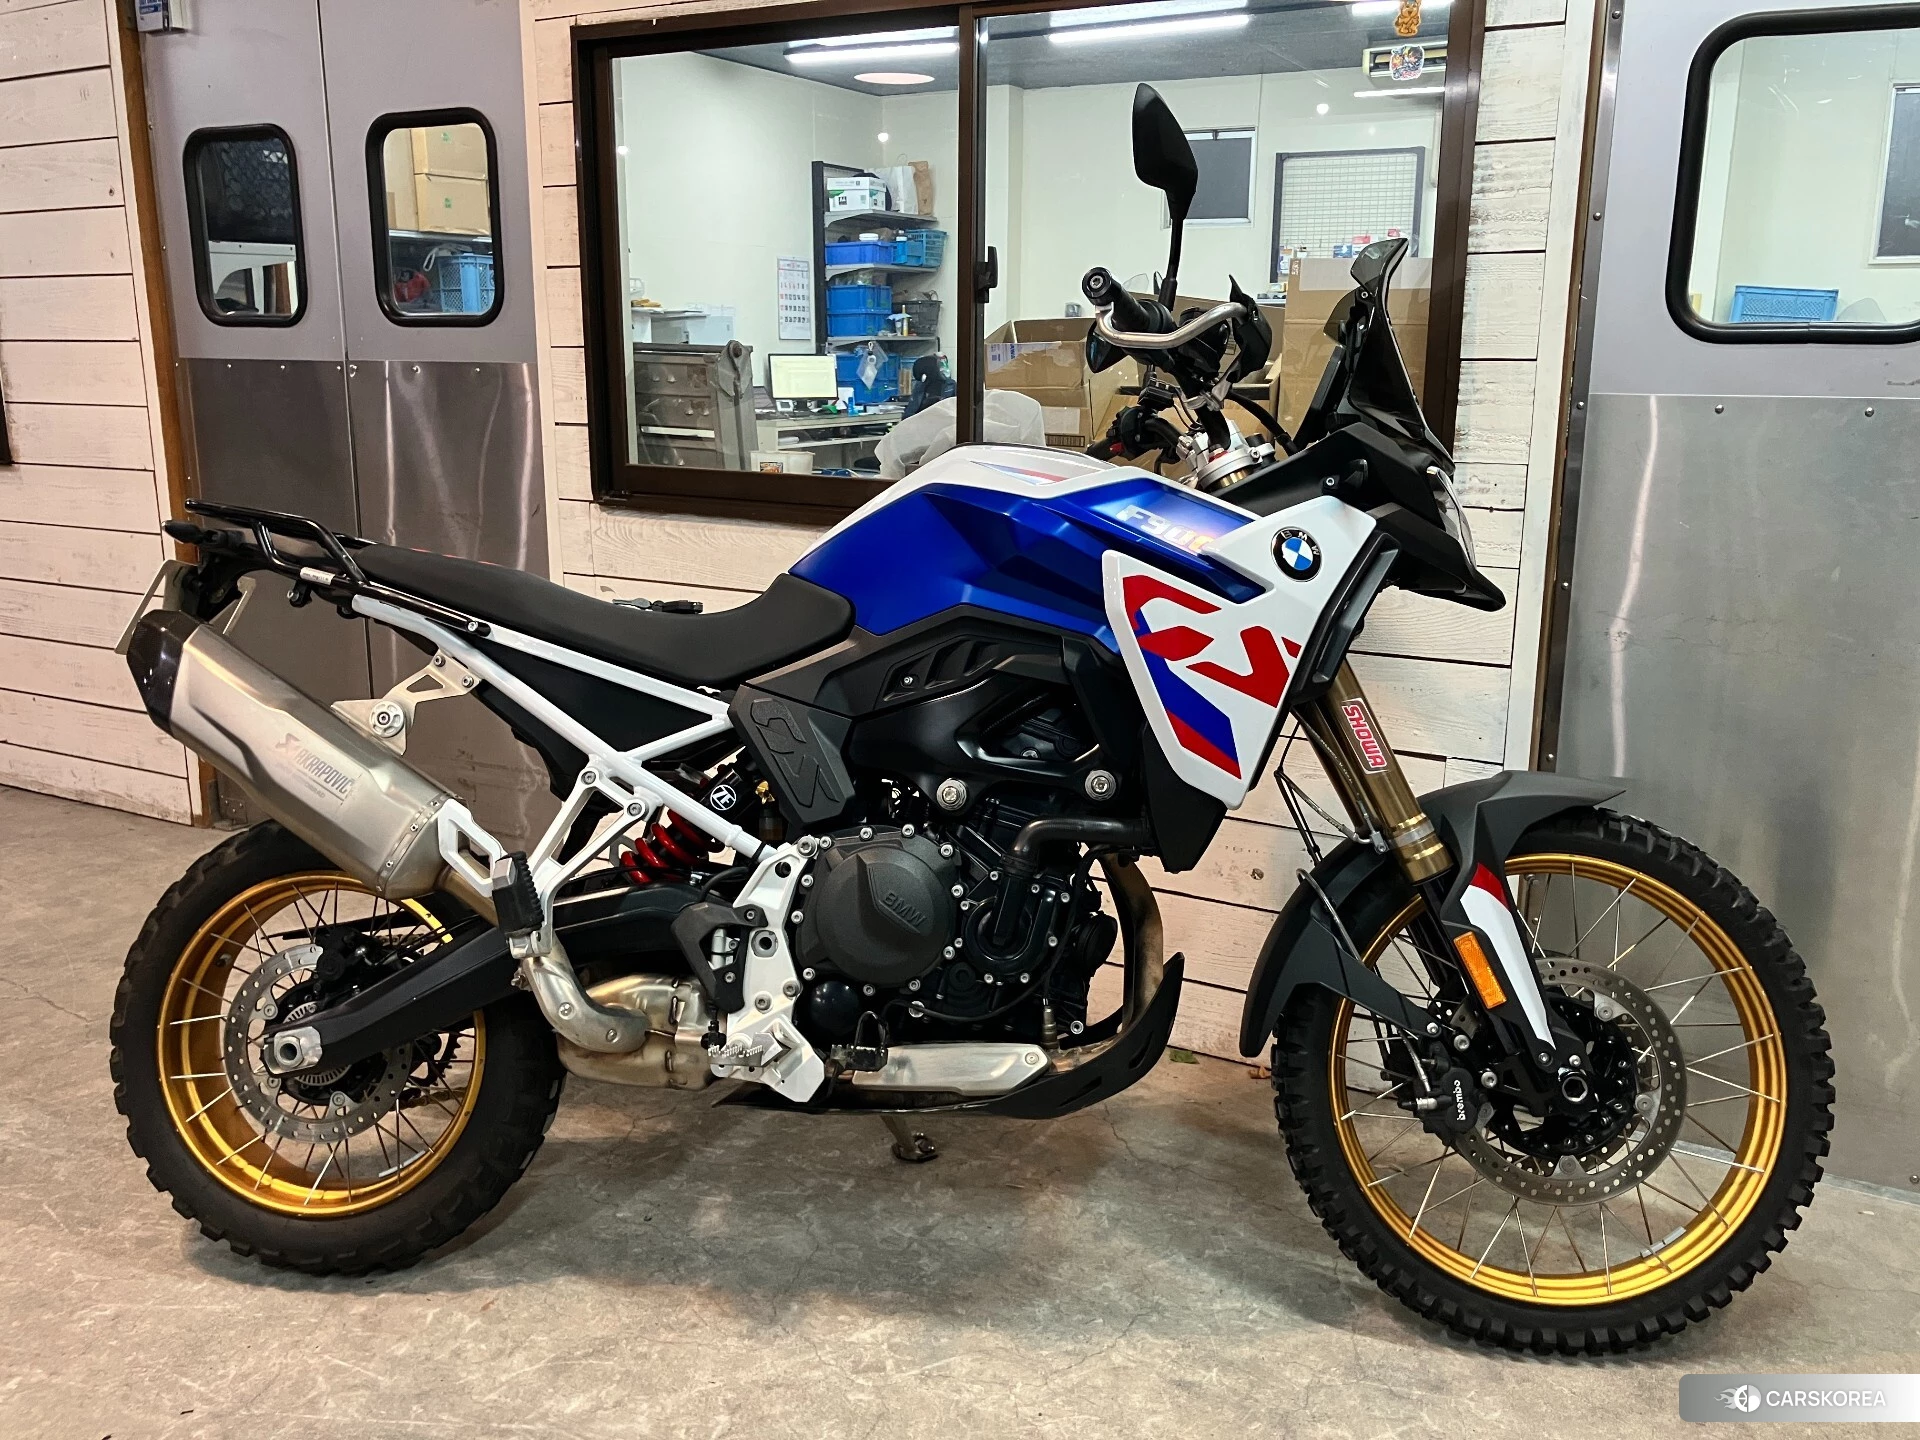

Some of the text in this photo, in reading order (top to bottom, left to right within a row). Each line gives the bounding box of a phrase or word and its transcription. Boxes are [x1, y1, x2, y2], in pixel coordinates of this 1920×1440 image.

[1280, 530, 1320, 556] BMW
[1342, 705, 1387, 768] SHOWA
[882, 891, 927, 928] BMW
[1453, 1079, 1466, 1121] brembo
